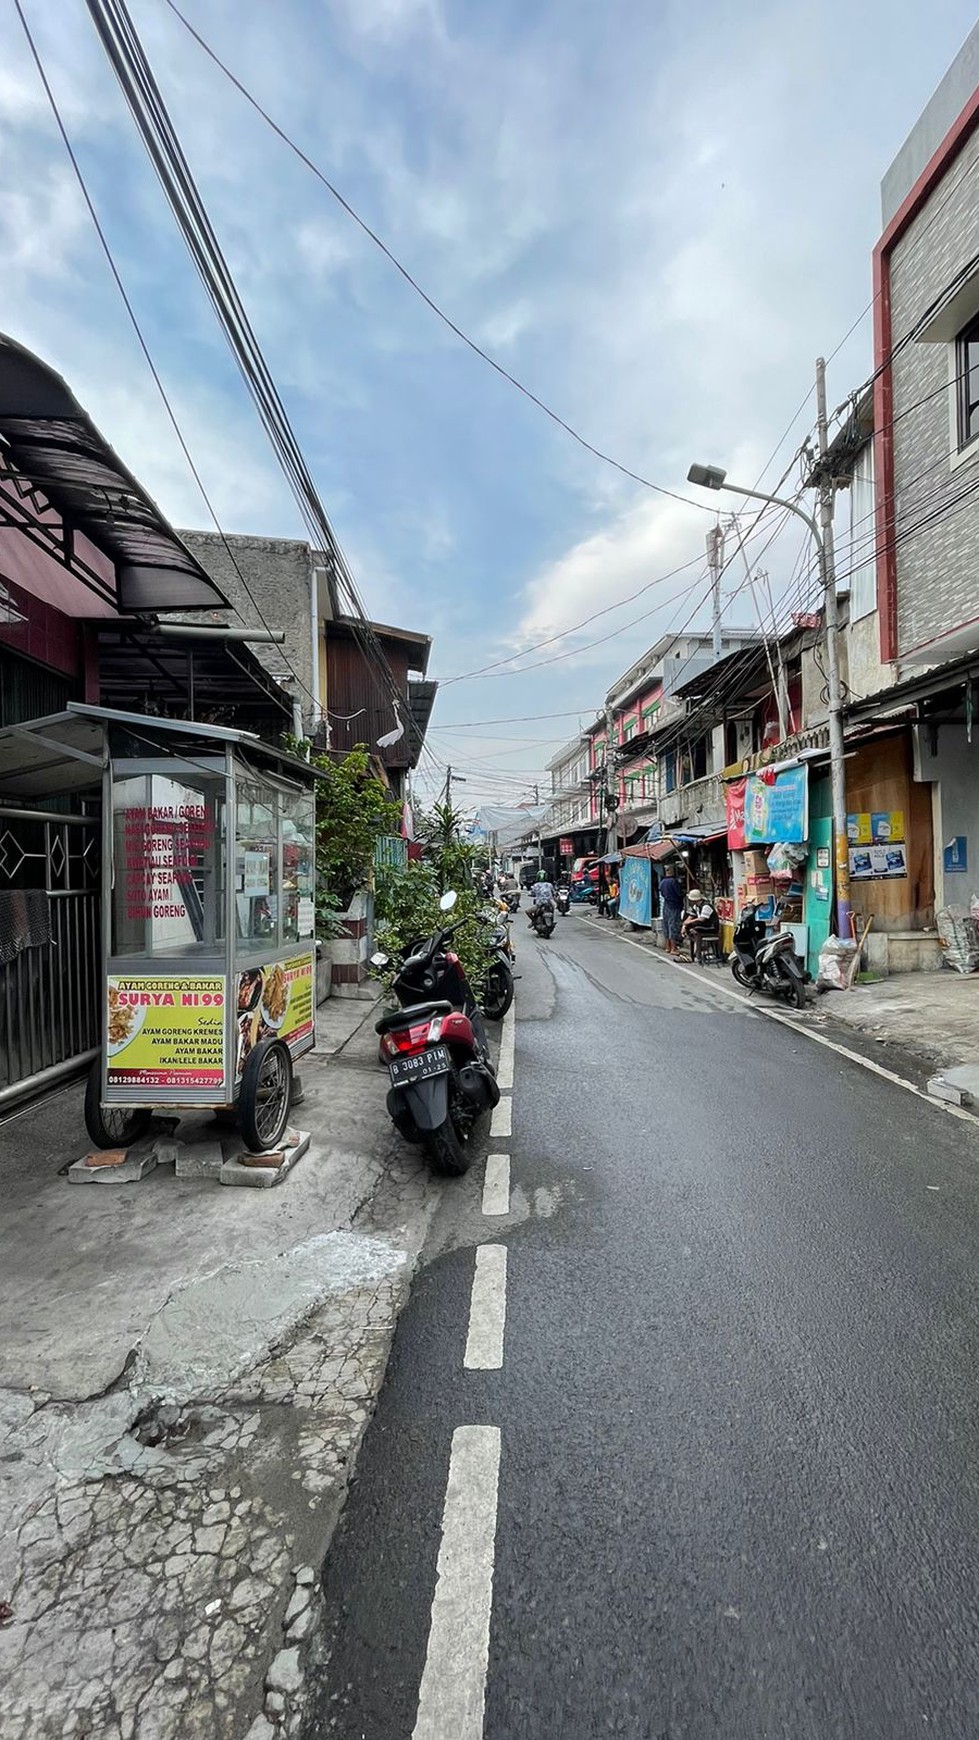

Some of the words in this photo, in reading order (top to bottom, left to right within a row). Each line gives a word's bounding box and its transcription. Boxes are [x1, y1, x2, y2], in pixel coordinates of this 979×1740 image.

[148, 806, 174, 819] BAKAR
[143, 839, 173, 852] GORENG
[149, 888, 169, 901] AYAM
[153, 904, 186, 917] GORENG
[119, 981, 145, 990] AYAM
[146, 981, 180, 990] GORENG
[181, 981, 188, 990] &
[189, 981, 222, 990] BAKAR
[119, 993, 175, 1006] SURYA
[198, 1017, 223, 1026] Sedia
[402, 1056, 424, 1071] 3083
